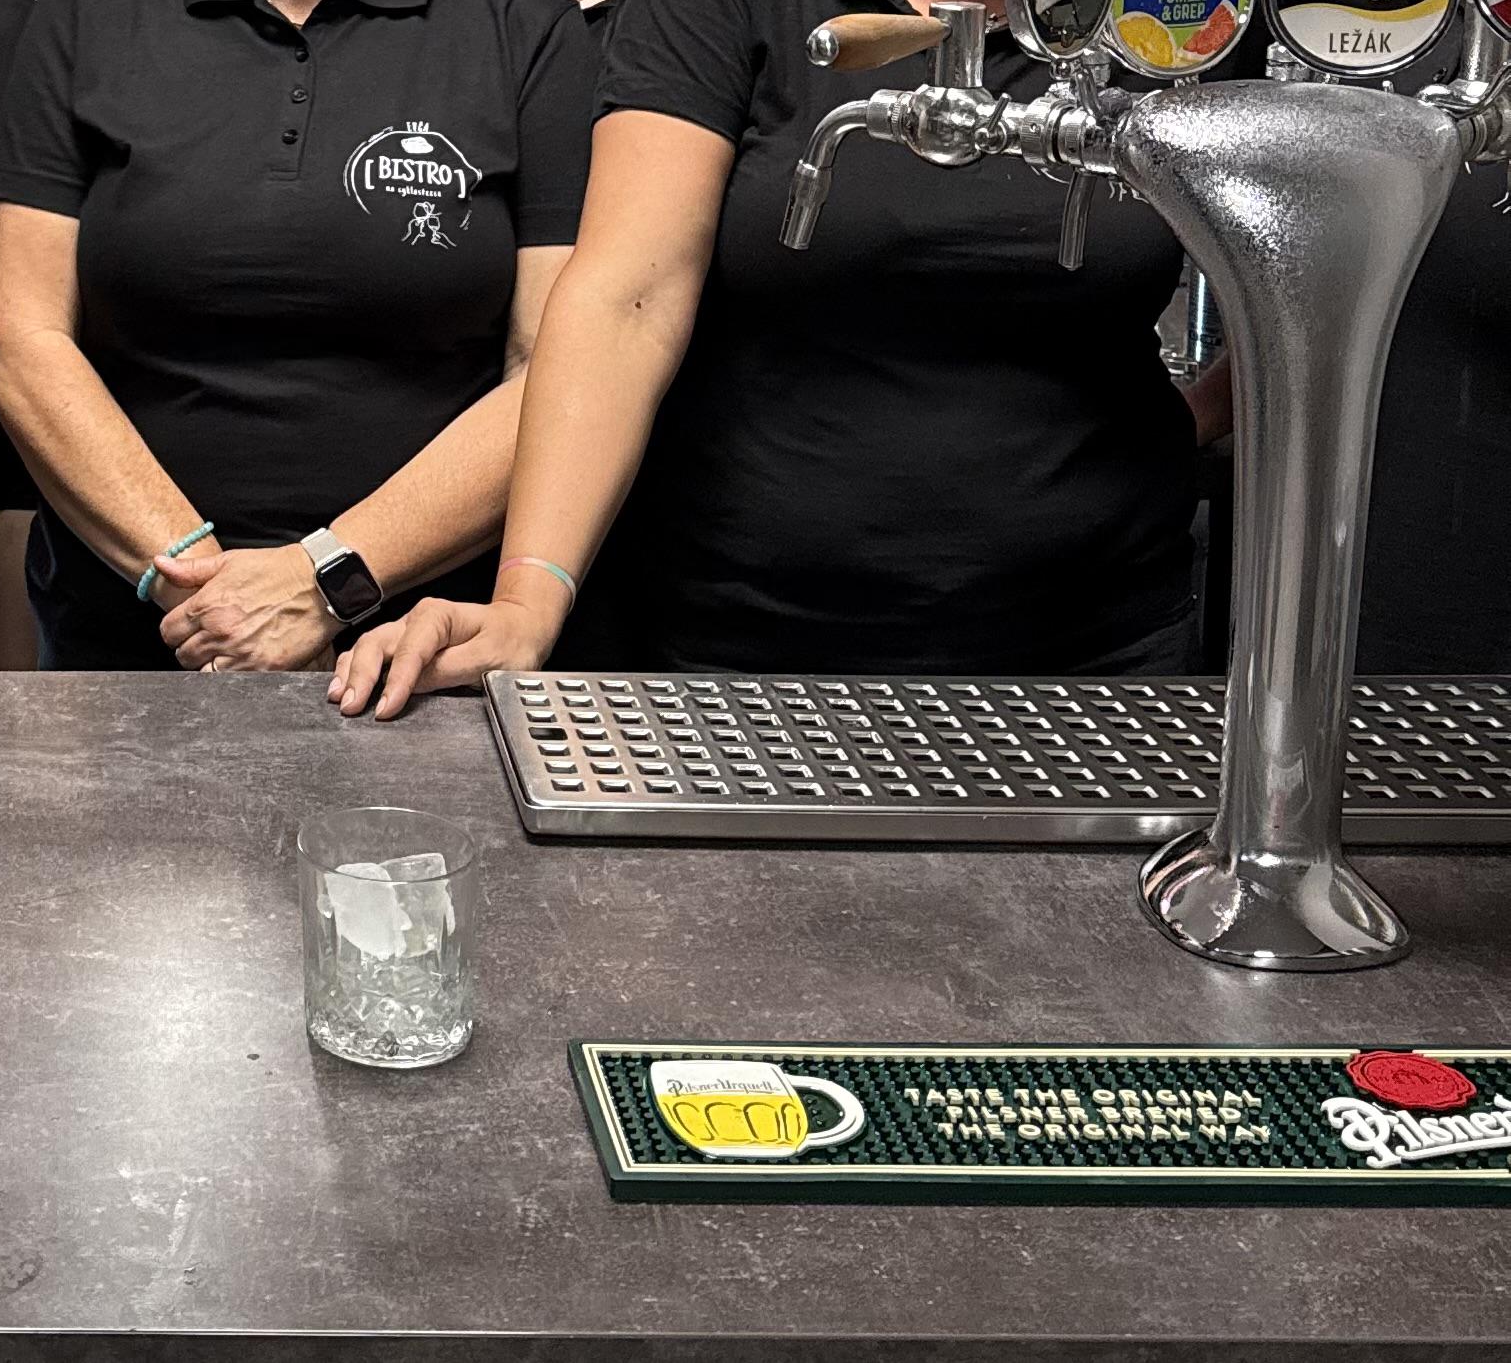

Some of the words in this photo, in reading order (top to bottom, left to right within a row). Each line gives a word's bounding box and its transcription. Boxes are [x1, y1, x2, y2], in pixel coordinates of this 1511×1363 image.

[1329, 27, 1392, 54] LEŽÁK
[378, 155, 453, 186] BISTRO
[903, 1088, 1004, 1108] TASTE
[1014, 1088, 1081, 1107] THE
[1092, 1089, 1262, 1109] ORIGINAL
[945, 1105, 1090, 1125] PILSNER
[1097, 1106, 1242, 1126] BREWED
[938, 1122, 1006, 1141] THE
[1017, 1123, 1191, 1143] ORIGINAL
[1198, 1124, 1272, 1144] WAY
